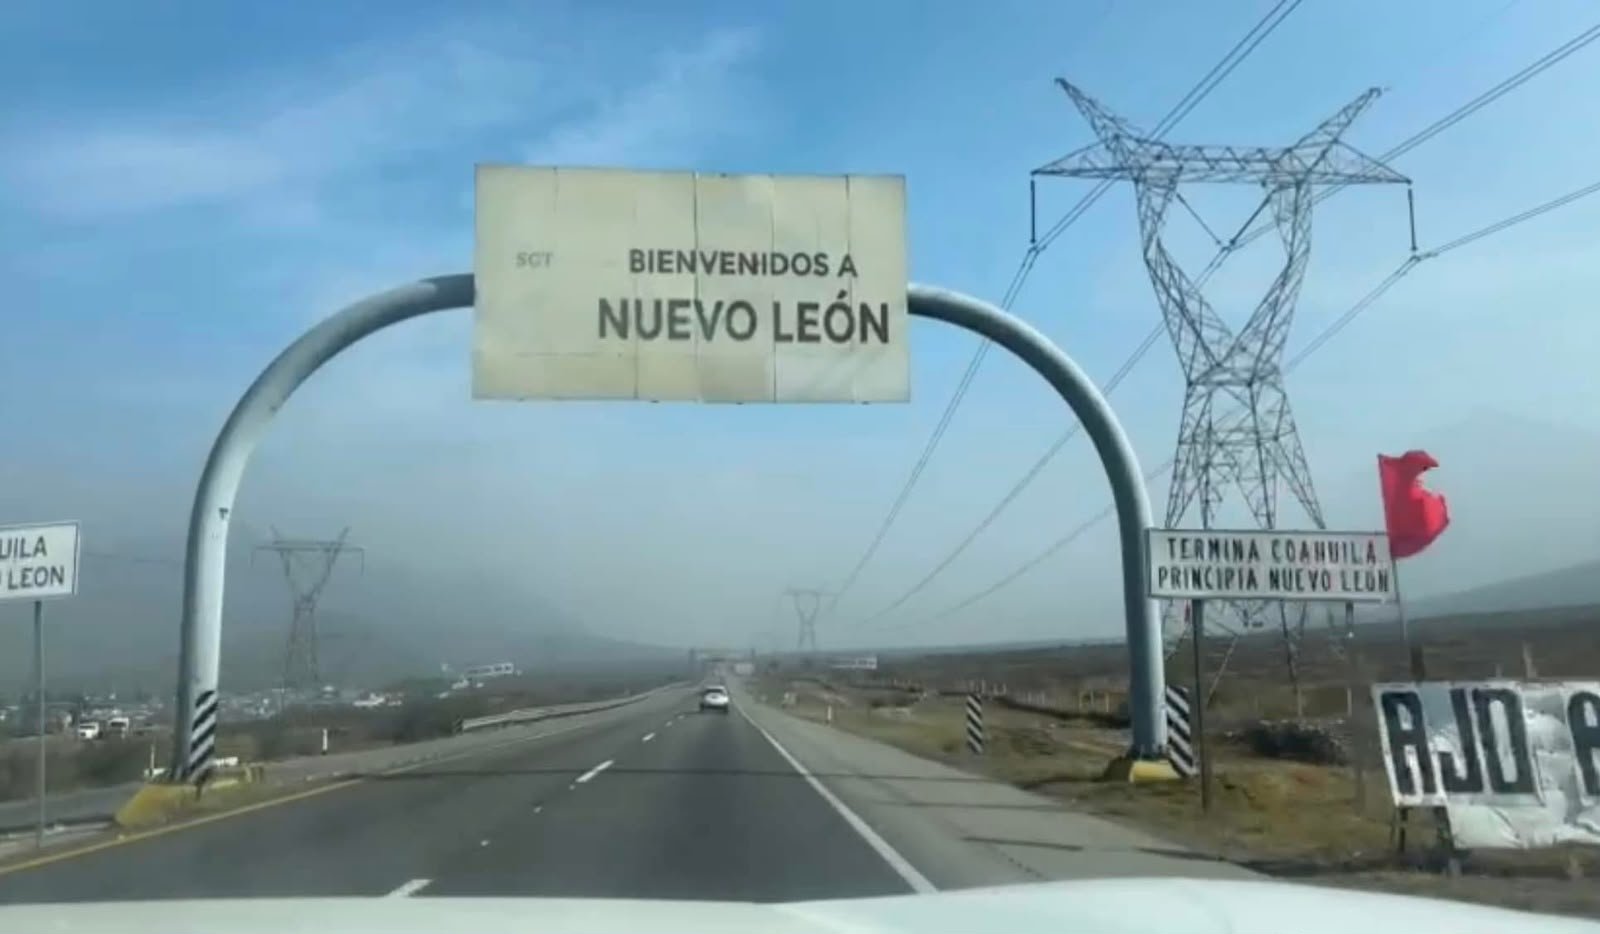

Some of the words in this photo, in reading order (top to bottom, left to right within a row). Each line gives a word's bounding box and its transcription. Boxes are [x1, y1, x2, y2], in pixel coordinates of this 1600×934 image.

[628, 248, 830, 278] BIENVENIDOS
[837, 252, 859, 278] A
[597, 296, 758, 342] NUEVO
[772, 289, 890, 344] LEÓN
[1167, 537, 1261, 562] TERMINA
[1271, 539, 1377, 564] COAHUILA
[7, 565, 65, 590] LEON
[1158, 566, 1259, 591] PRINCIPIA
[1268, 567, 1332, 592] NUEVO
